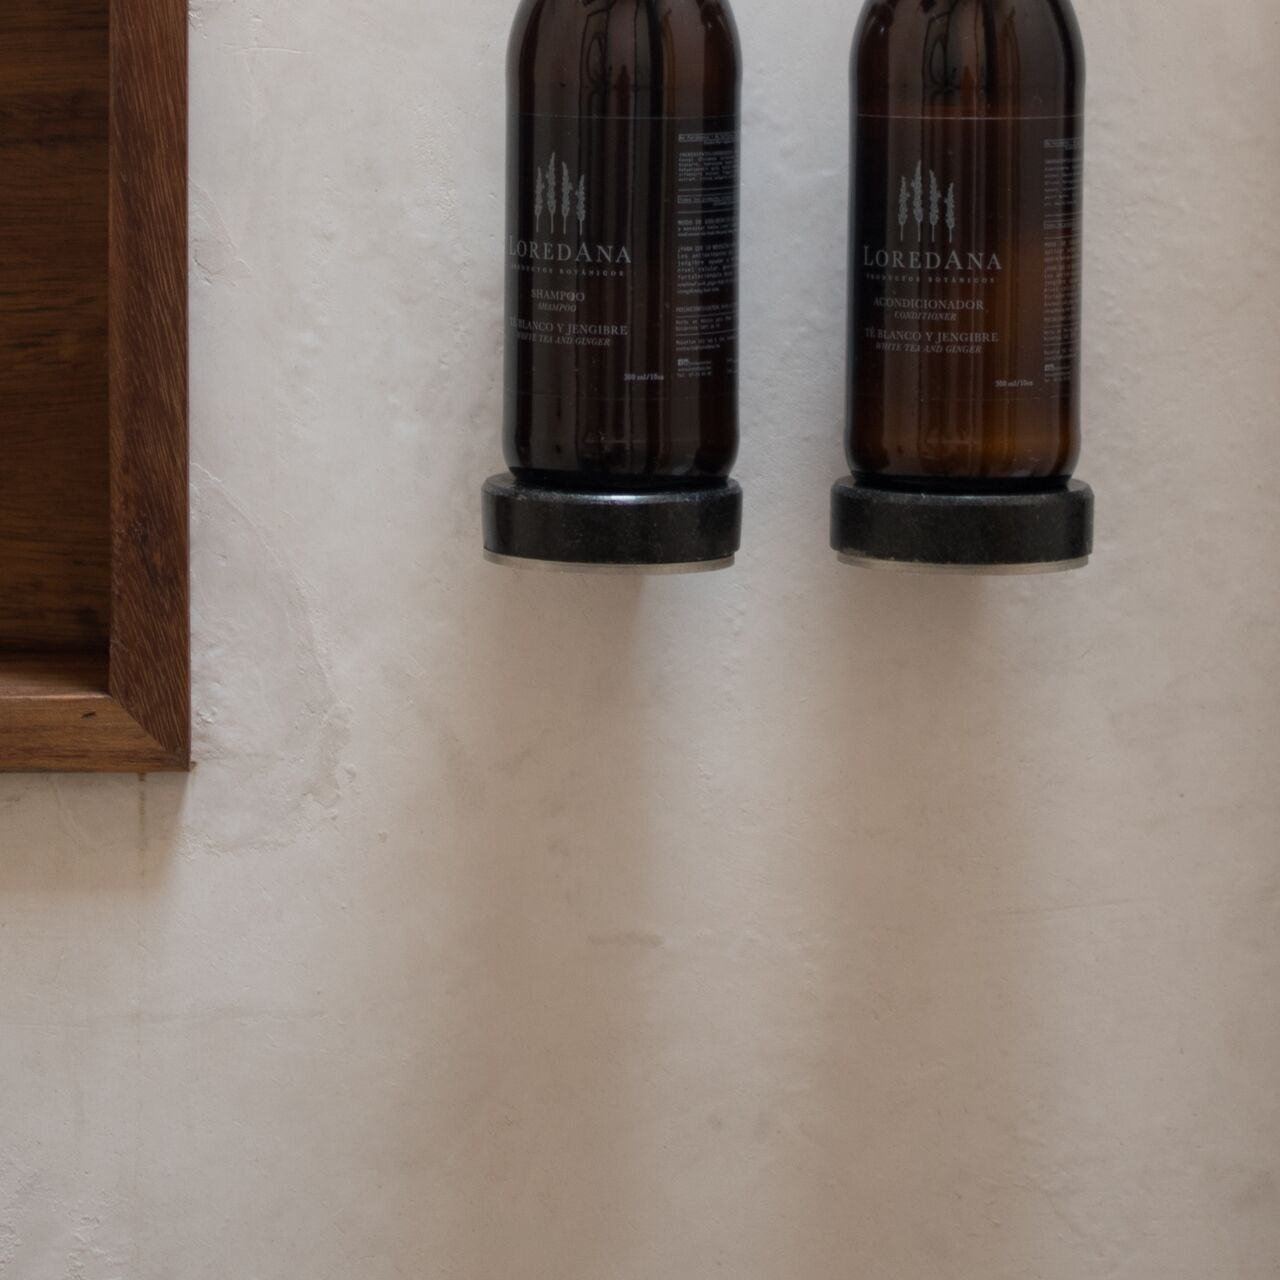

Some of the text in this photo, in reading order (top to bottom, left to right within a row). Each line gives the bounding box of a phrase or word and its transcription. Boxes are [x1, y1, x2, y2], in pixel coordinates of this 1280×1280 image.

[509, 234, 631, 263] LOREDANA
[863, 245, 1002, 270] LOREDANA
[530, 288, 585, 302] SHAMPOO
[537, 303, 577, 313] SHAMPOO
[872, 296, 984, 310] ACONDICIONADOR
[894, 311, 958, 321] CONDITIONER
[557, 322, 565, 332] Y
[565, 323, 629, 336] JENGIBRE
[865, 325, 999, 344] TÉ BLANCO Y JENGIBRE
[539, 334, 553, 344] TEA
[555, 335, 573, 345] AND
[575, 336, 611, 347] GINGER
[875, 342, 983, 354] WHITE TEA AND GINGER
